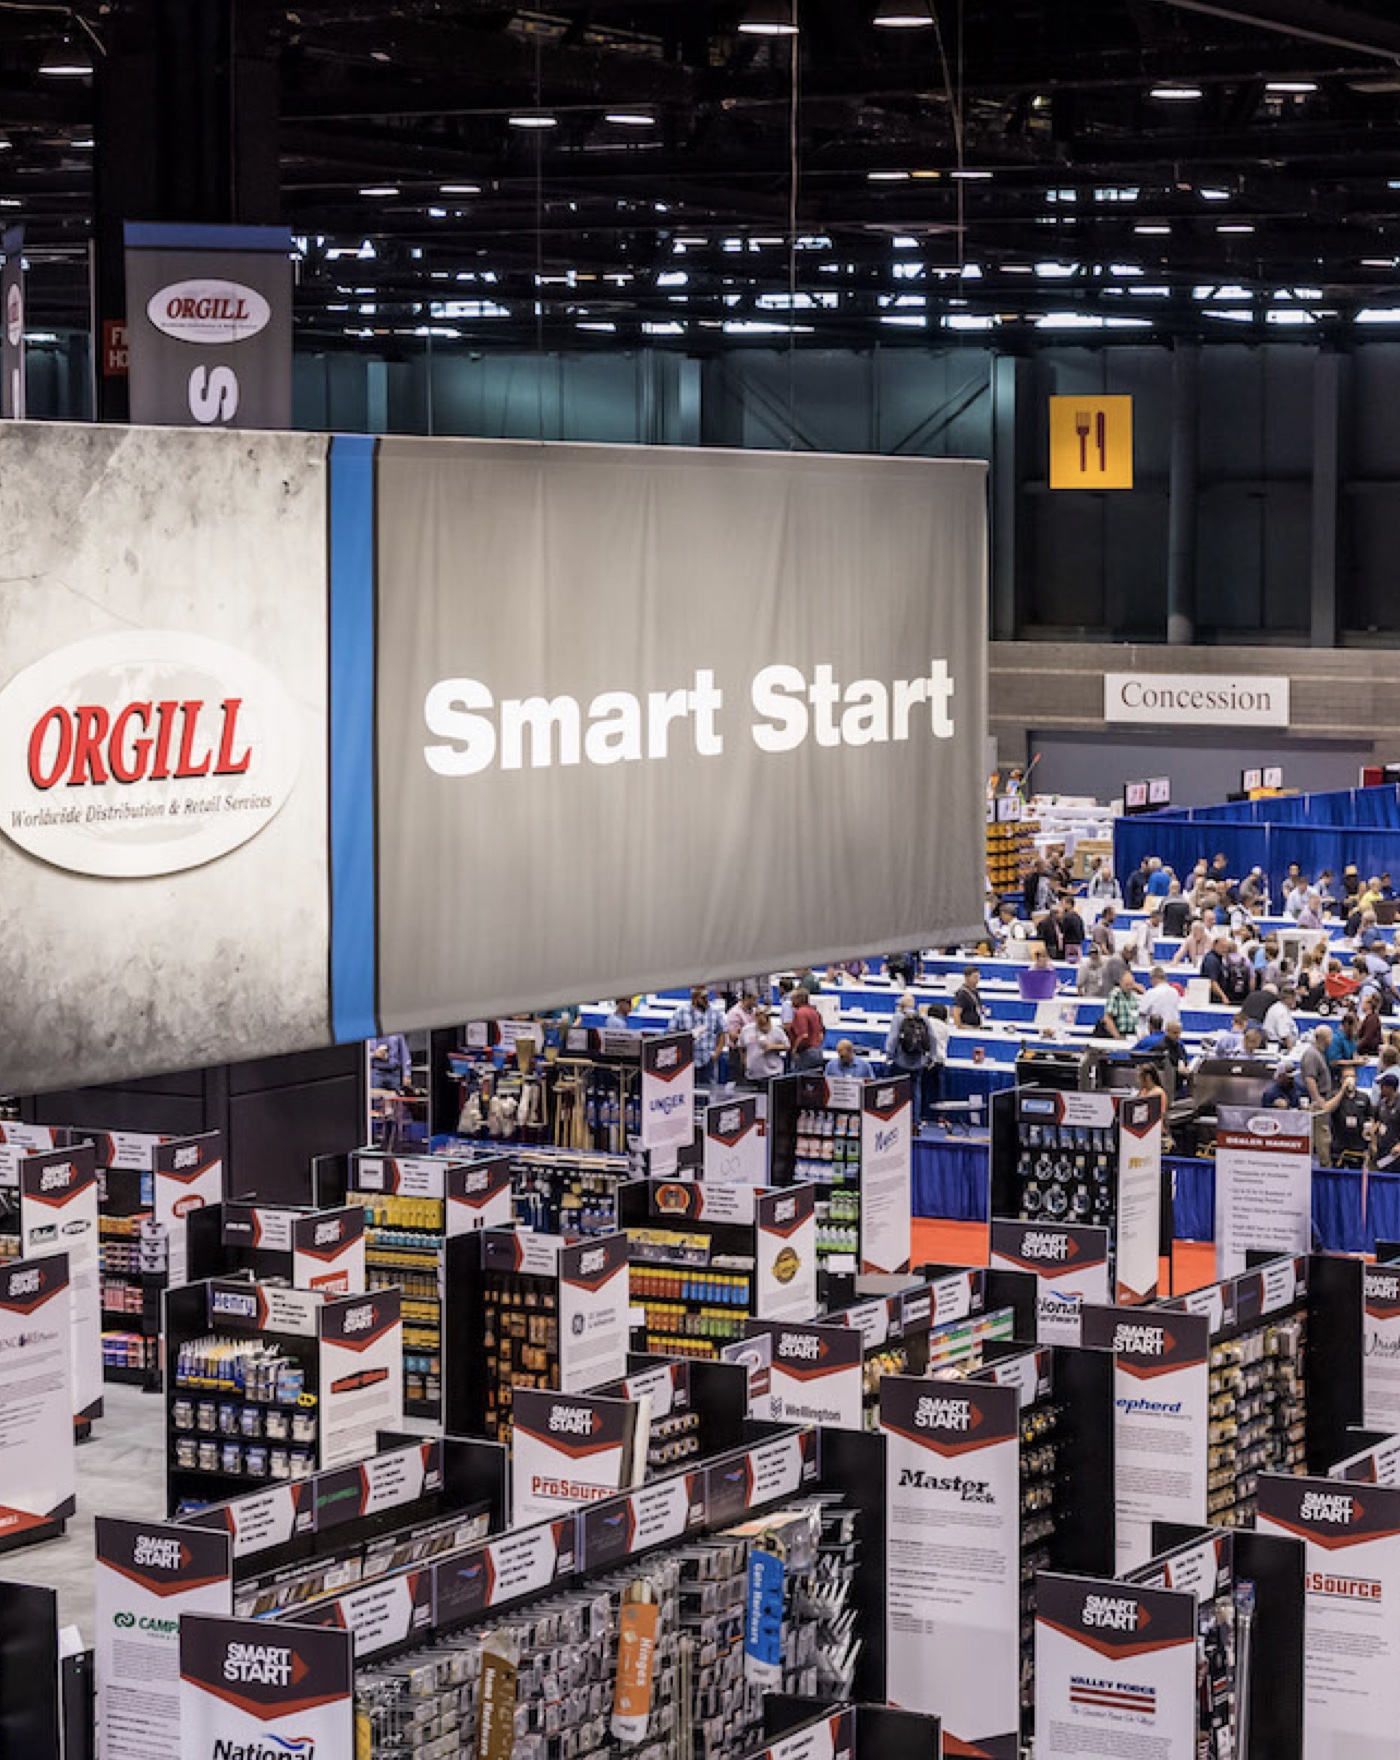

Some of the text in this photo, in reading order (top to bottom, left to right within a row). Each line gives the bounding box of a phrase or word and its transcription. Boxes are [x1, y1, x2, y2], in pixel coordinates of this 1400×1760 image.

[167, 297, 250, 319] ORGILL
[1121, 682, 1271, 711] Concession
[423, 659, 954, 777] Smart Start
[27, 698, 252, 790] ORGILL
[11, 793, 272, 828] Worldwide Distribution & Retail Services
[1226, 1136, 1302, 1151] DEALER MARKET
[1025, 1231, 1068, 1248] SMART
[1021, 1241, 1068, 1259] START
[1117, 1323, 1163, 1341] SMART
[1113, 1336, 1163, 1354] START
[785, 1404, 841, 1422] Wellington
[919, 1397, 970, 1415] SMART
[549, 1417, 592, 1434] START
[915, 1410, 971, 1431] START
[899, 1469, 989, 1494] Master
[1304, 1492, 1353, 1510] SMART
[1300, 1504, 1353, 1523] START
[136, 1535, 180, 1553] SMART
[133, 1549, 182, 1570] START
[1086, 1595, 1138, 1615] SMART
[139, 1616, 180, 1633] CAMP
[1082, 1608, 1138, 1631] START
[227, 1643, 291, 1666] SMART
[223, 1660, 292, 1686] START
[1070, 1675, 1156, 1695] VALLEY FORGE
[213, 1738, 315, 1760] National
